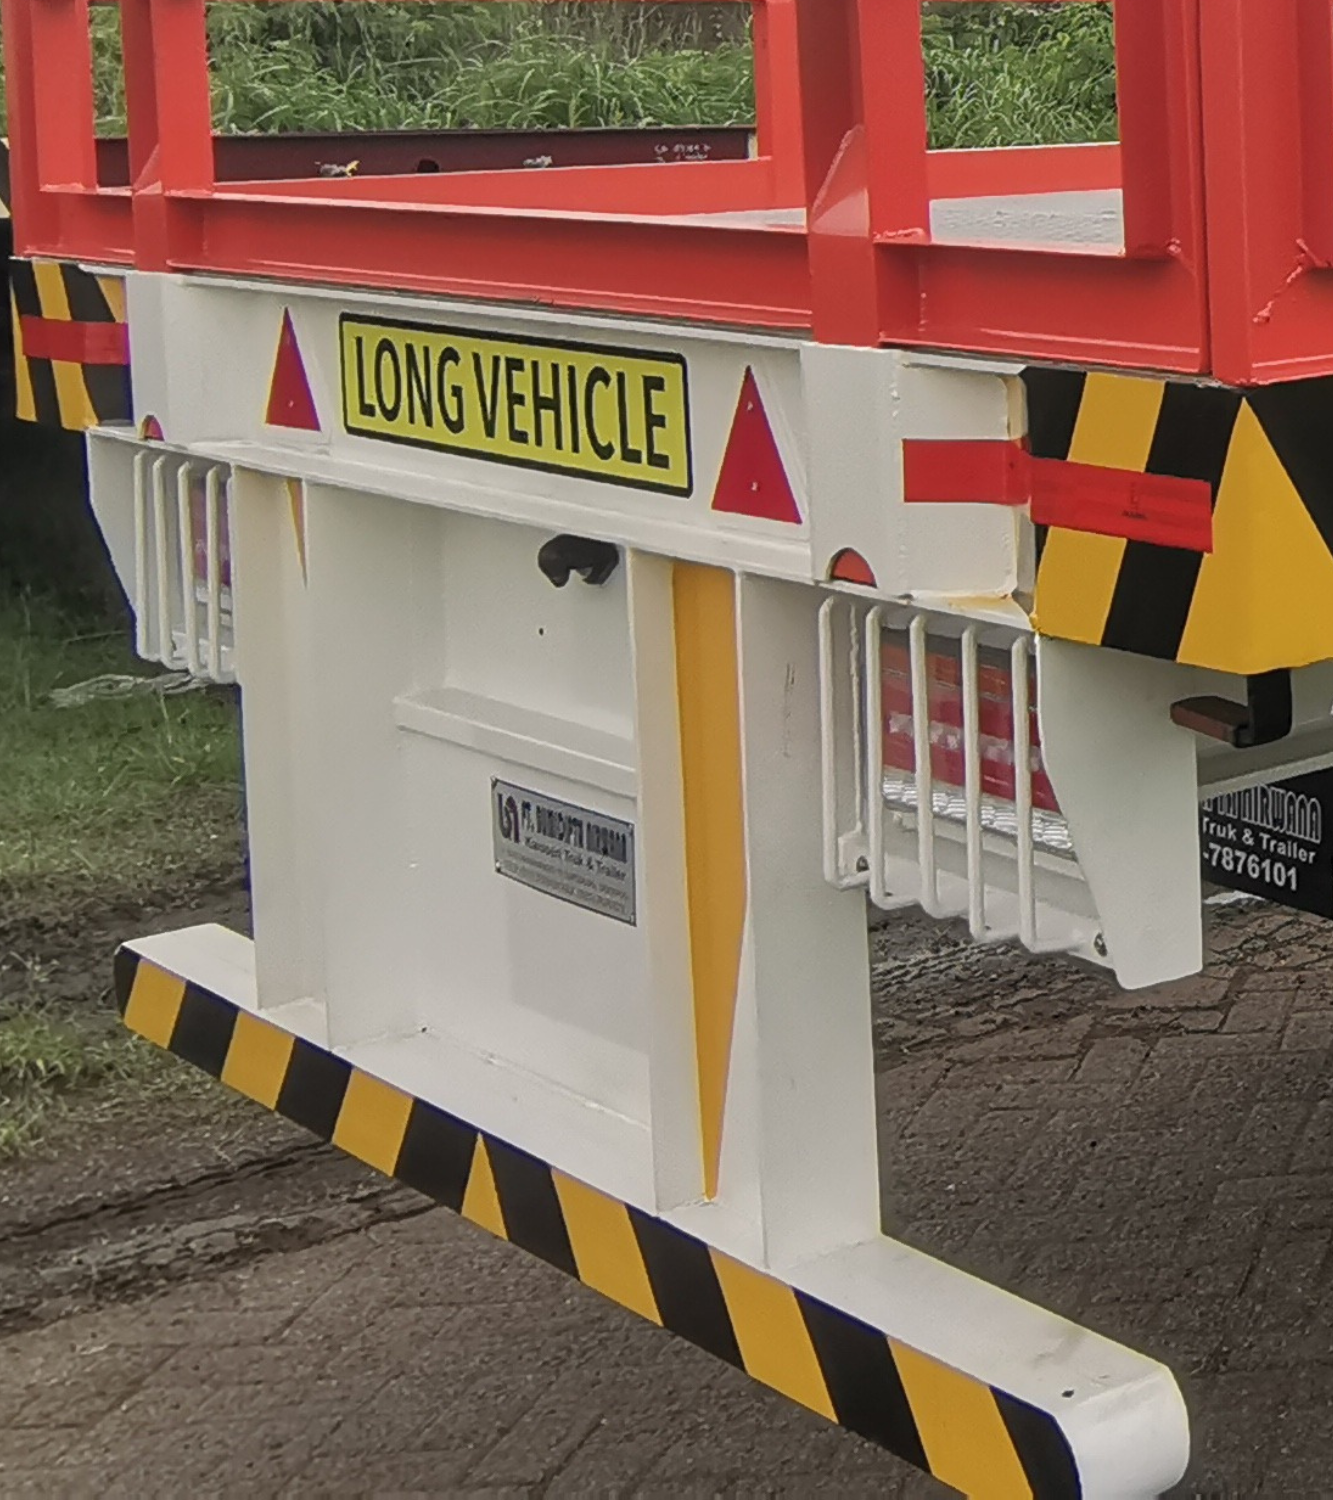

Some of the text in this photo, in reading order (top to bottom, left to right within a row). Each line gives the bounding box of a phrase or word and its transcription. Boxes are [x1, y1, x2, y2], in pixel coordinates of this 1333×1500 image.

[356, 335, 670, 470] LONG VEHICLE
[1242, 828, 1255, 846] &
[1259, 832, 1316, 864] Trailer
